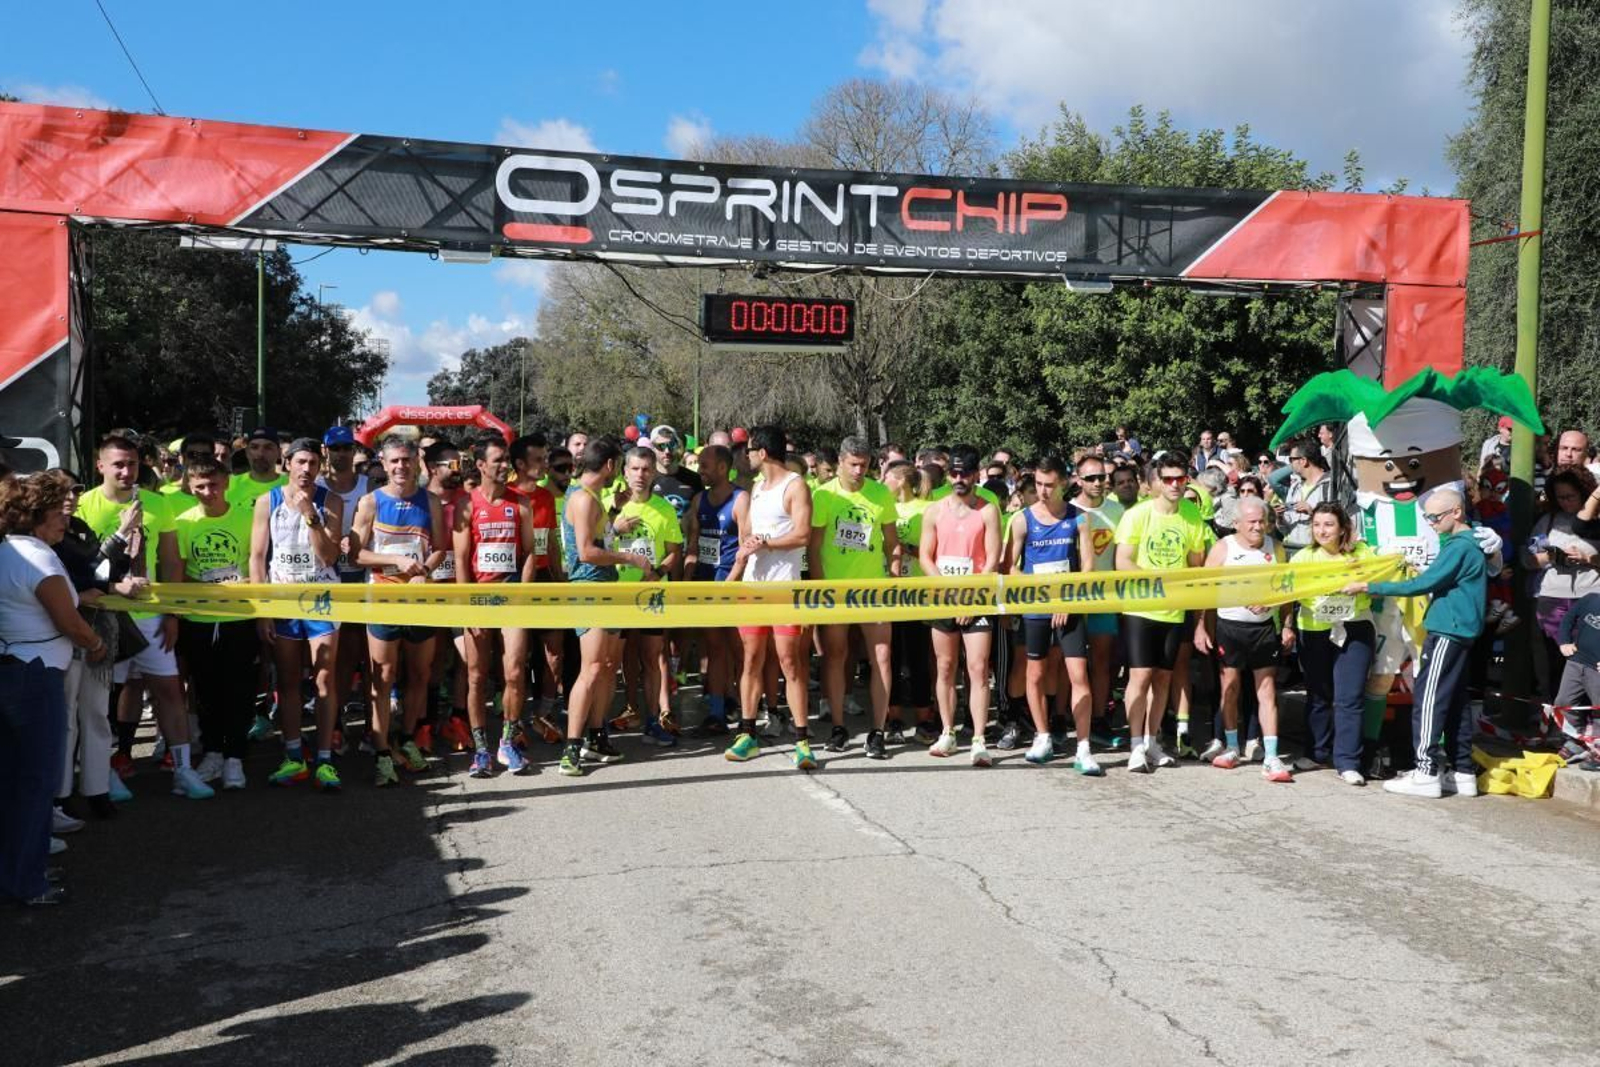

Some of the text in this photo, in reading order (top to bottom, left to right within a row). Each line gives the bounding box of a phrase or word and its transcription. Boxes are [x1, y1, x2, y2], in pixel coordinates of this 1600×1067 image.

[608, 229, 752, 249] CRONOMETRAJE
[758, 239, 770, 250] Y
[854, 243, 878, 255] DE
[884, 244, 961, 259] EVENTOS
[967, 248, 1067, 262] DEPORTIVOS
[840, 528, 866, 541] 1879
[280, 553, 310, 564] 5963
[484, 552, 514, 563] 5604
[791, 576, 1166, 609] TUS KILÓMETROS NOS DAN VIDA
[1320, 604, 1352, 616] 3297
